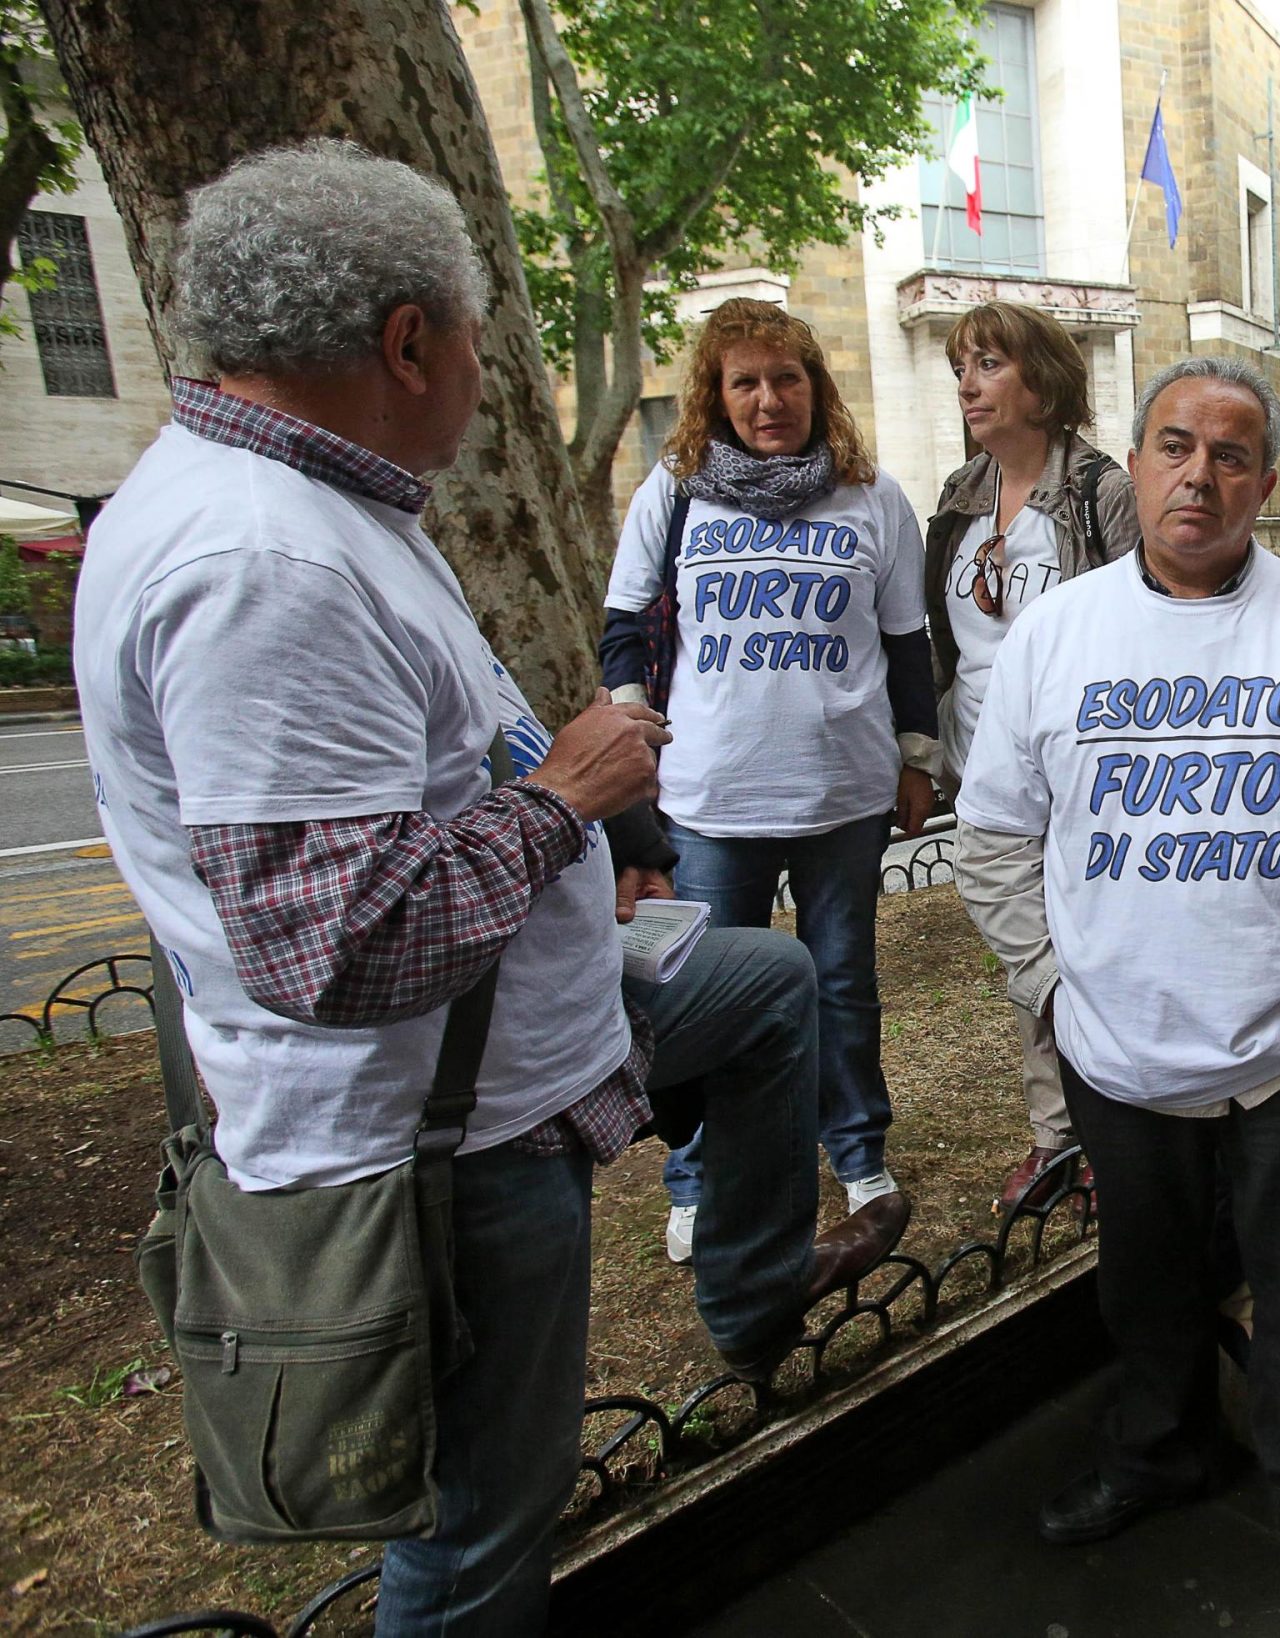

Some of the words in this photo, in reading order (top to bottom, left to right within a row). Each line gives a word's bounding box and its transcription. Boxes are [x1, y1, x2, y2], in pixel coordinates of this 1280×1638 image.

[685, 517, 858, 560] ESODATO
[1084, 500, 1092, 537] Quechua
[695, 569, 851, 623] FURTO
[697, 634, 732, 673] DI
[740, 631, 849, 673] STATO
[1085, 832, 1132, 881] DI
